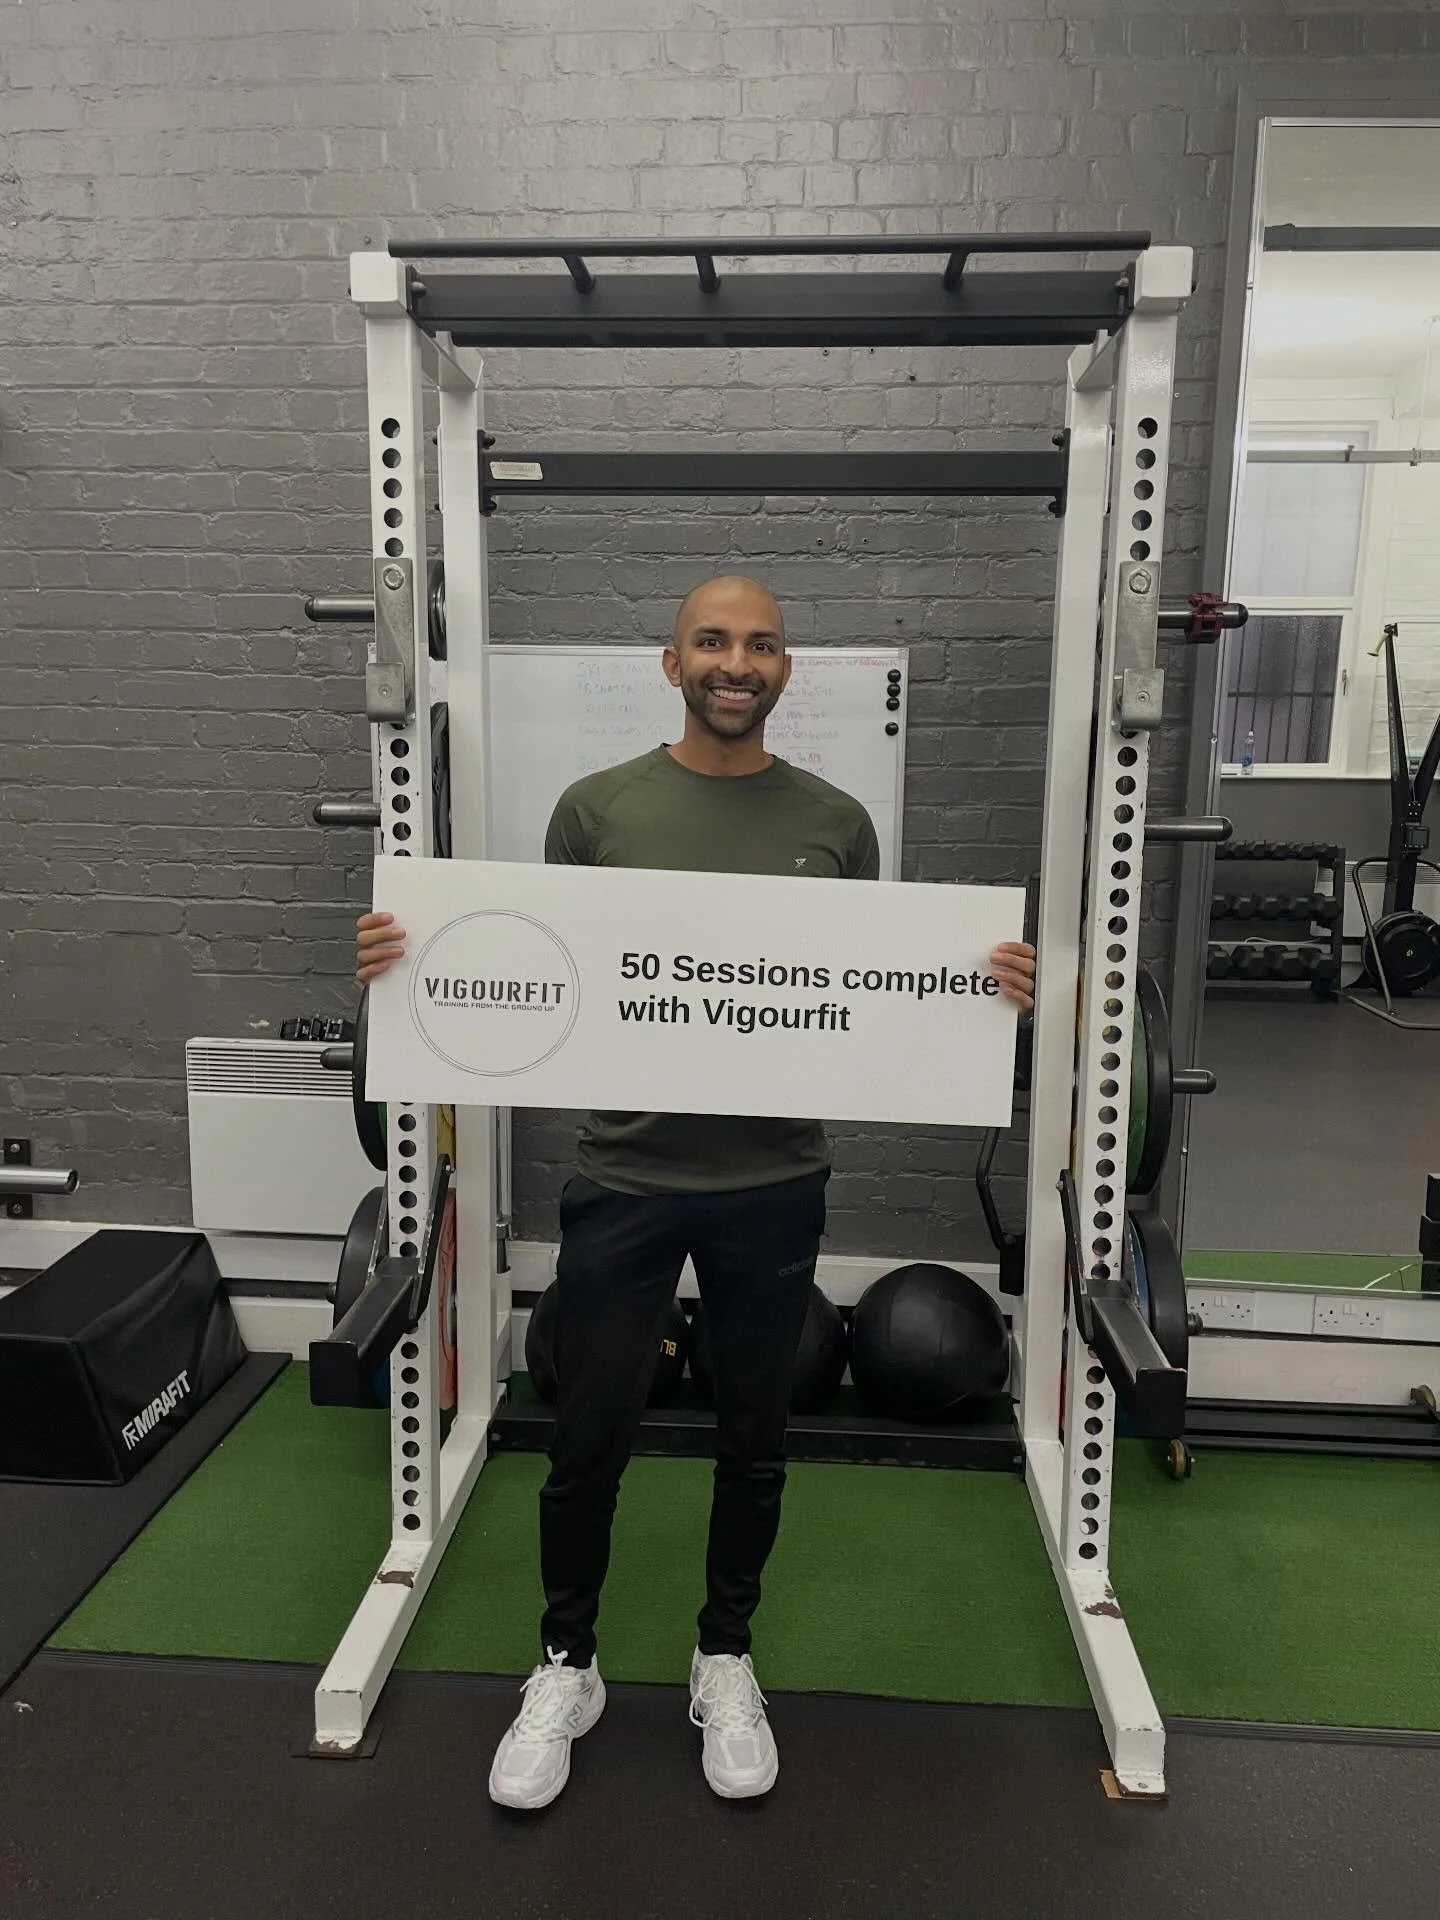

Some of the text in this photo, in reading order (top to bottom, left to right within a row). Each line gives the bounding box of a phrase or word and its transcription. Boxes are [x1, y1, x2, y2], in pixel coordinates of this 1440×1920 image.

[424, 977, 566, 1004] VIGOURFIT
[620, 953, 1001, 1001] 50 Sessions complete
[433, 1001, 469, 1009] TRAINING
[511, 1004, 543, 1012] GROUND
[618, 995, 851, 1034] with Vigourfit
[133, 1369, 191, 1439] MIRAFIT
